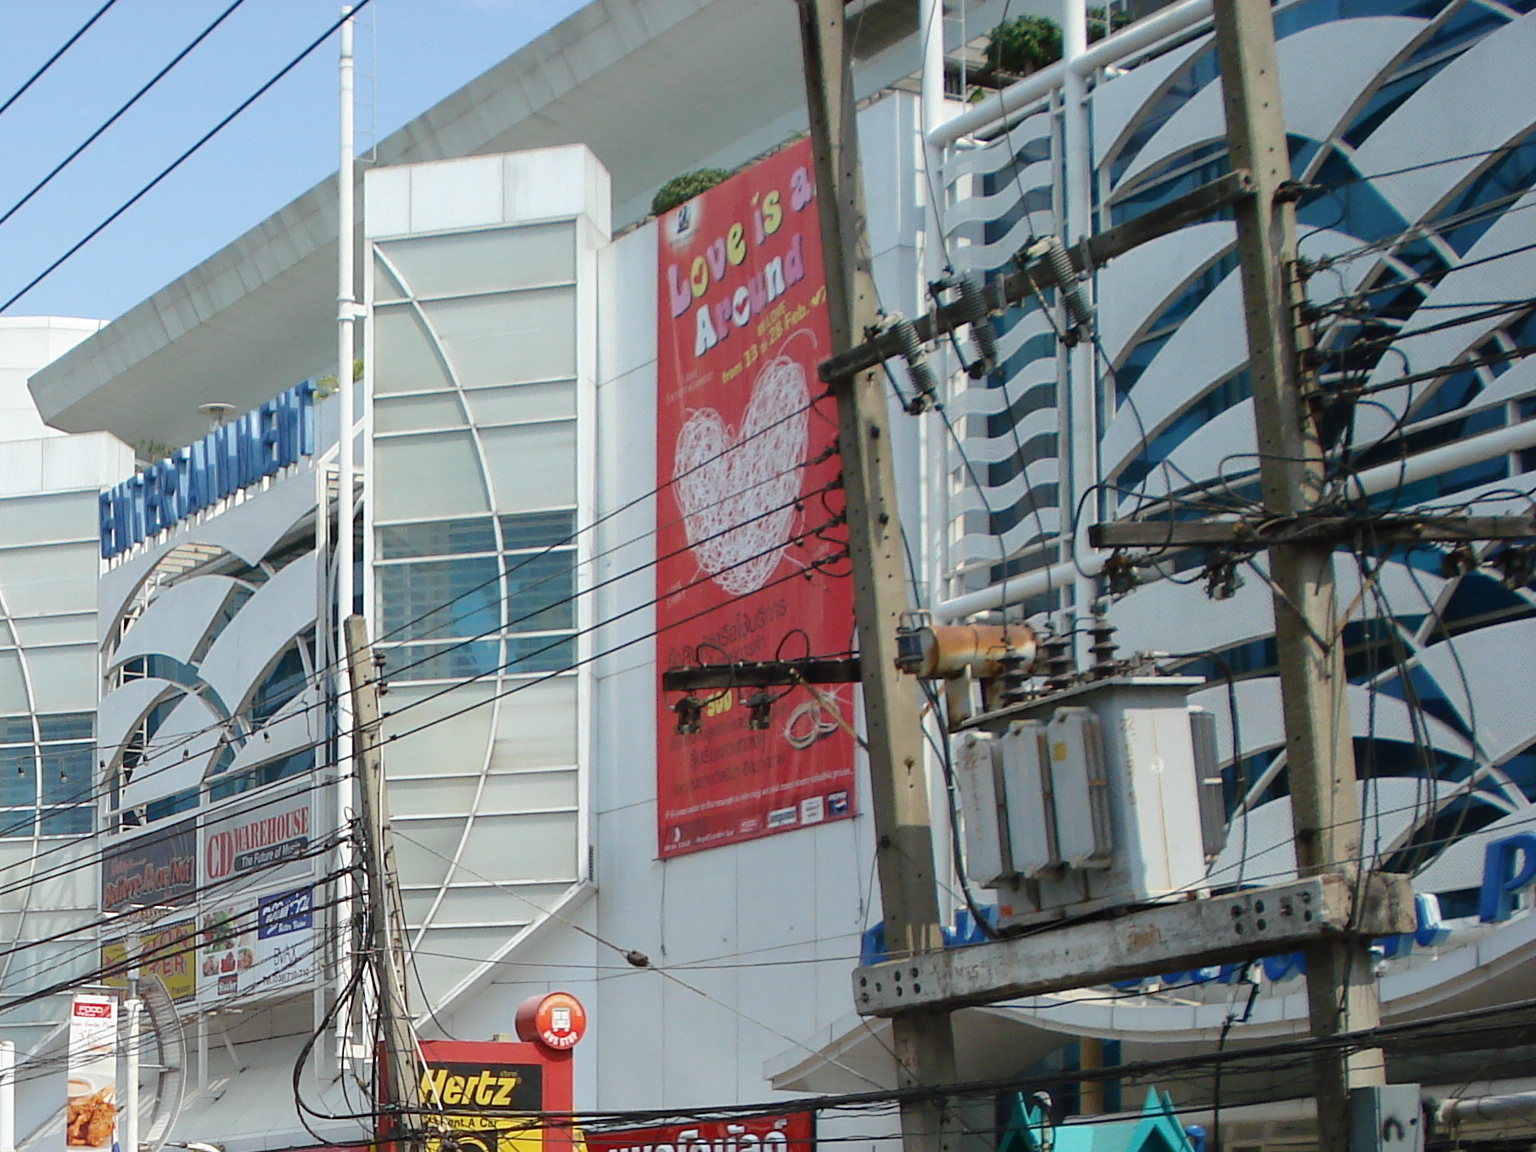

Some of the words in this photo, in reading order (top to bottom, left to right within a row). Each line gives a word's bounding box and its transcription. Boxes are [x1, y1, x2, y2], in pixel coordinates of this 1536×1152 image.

[667, 221, 747, 319] Love
[749, 190, 783, 246] is
[694, 231, 806, 359] Around
[785, 303, 811, 331] Feb.
[98, 376, 317, 560] ENTERTAINMENT
[206, 830, 234, 880] CD
[234, 806, 310, 853] WAREHOUSE
[78, 1005, 104, 1014] FOOD
[419, 1068, 518, 1107] Hertz
